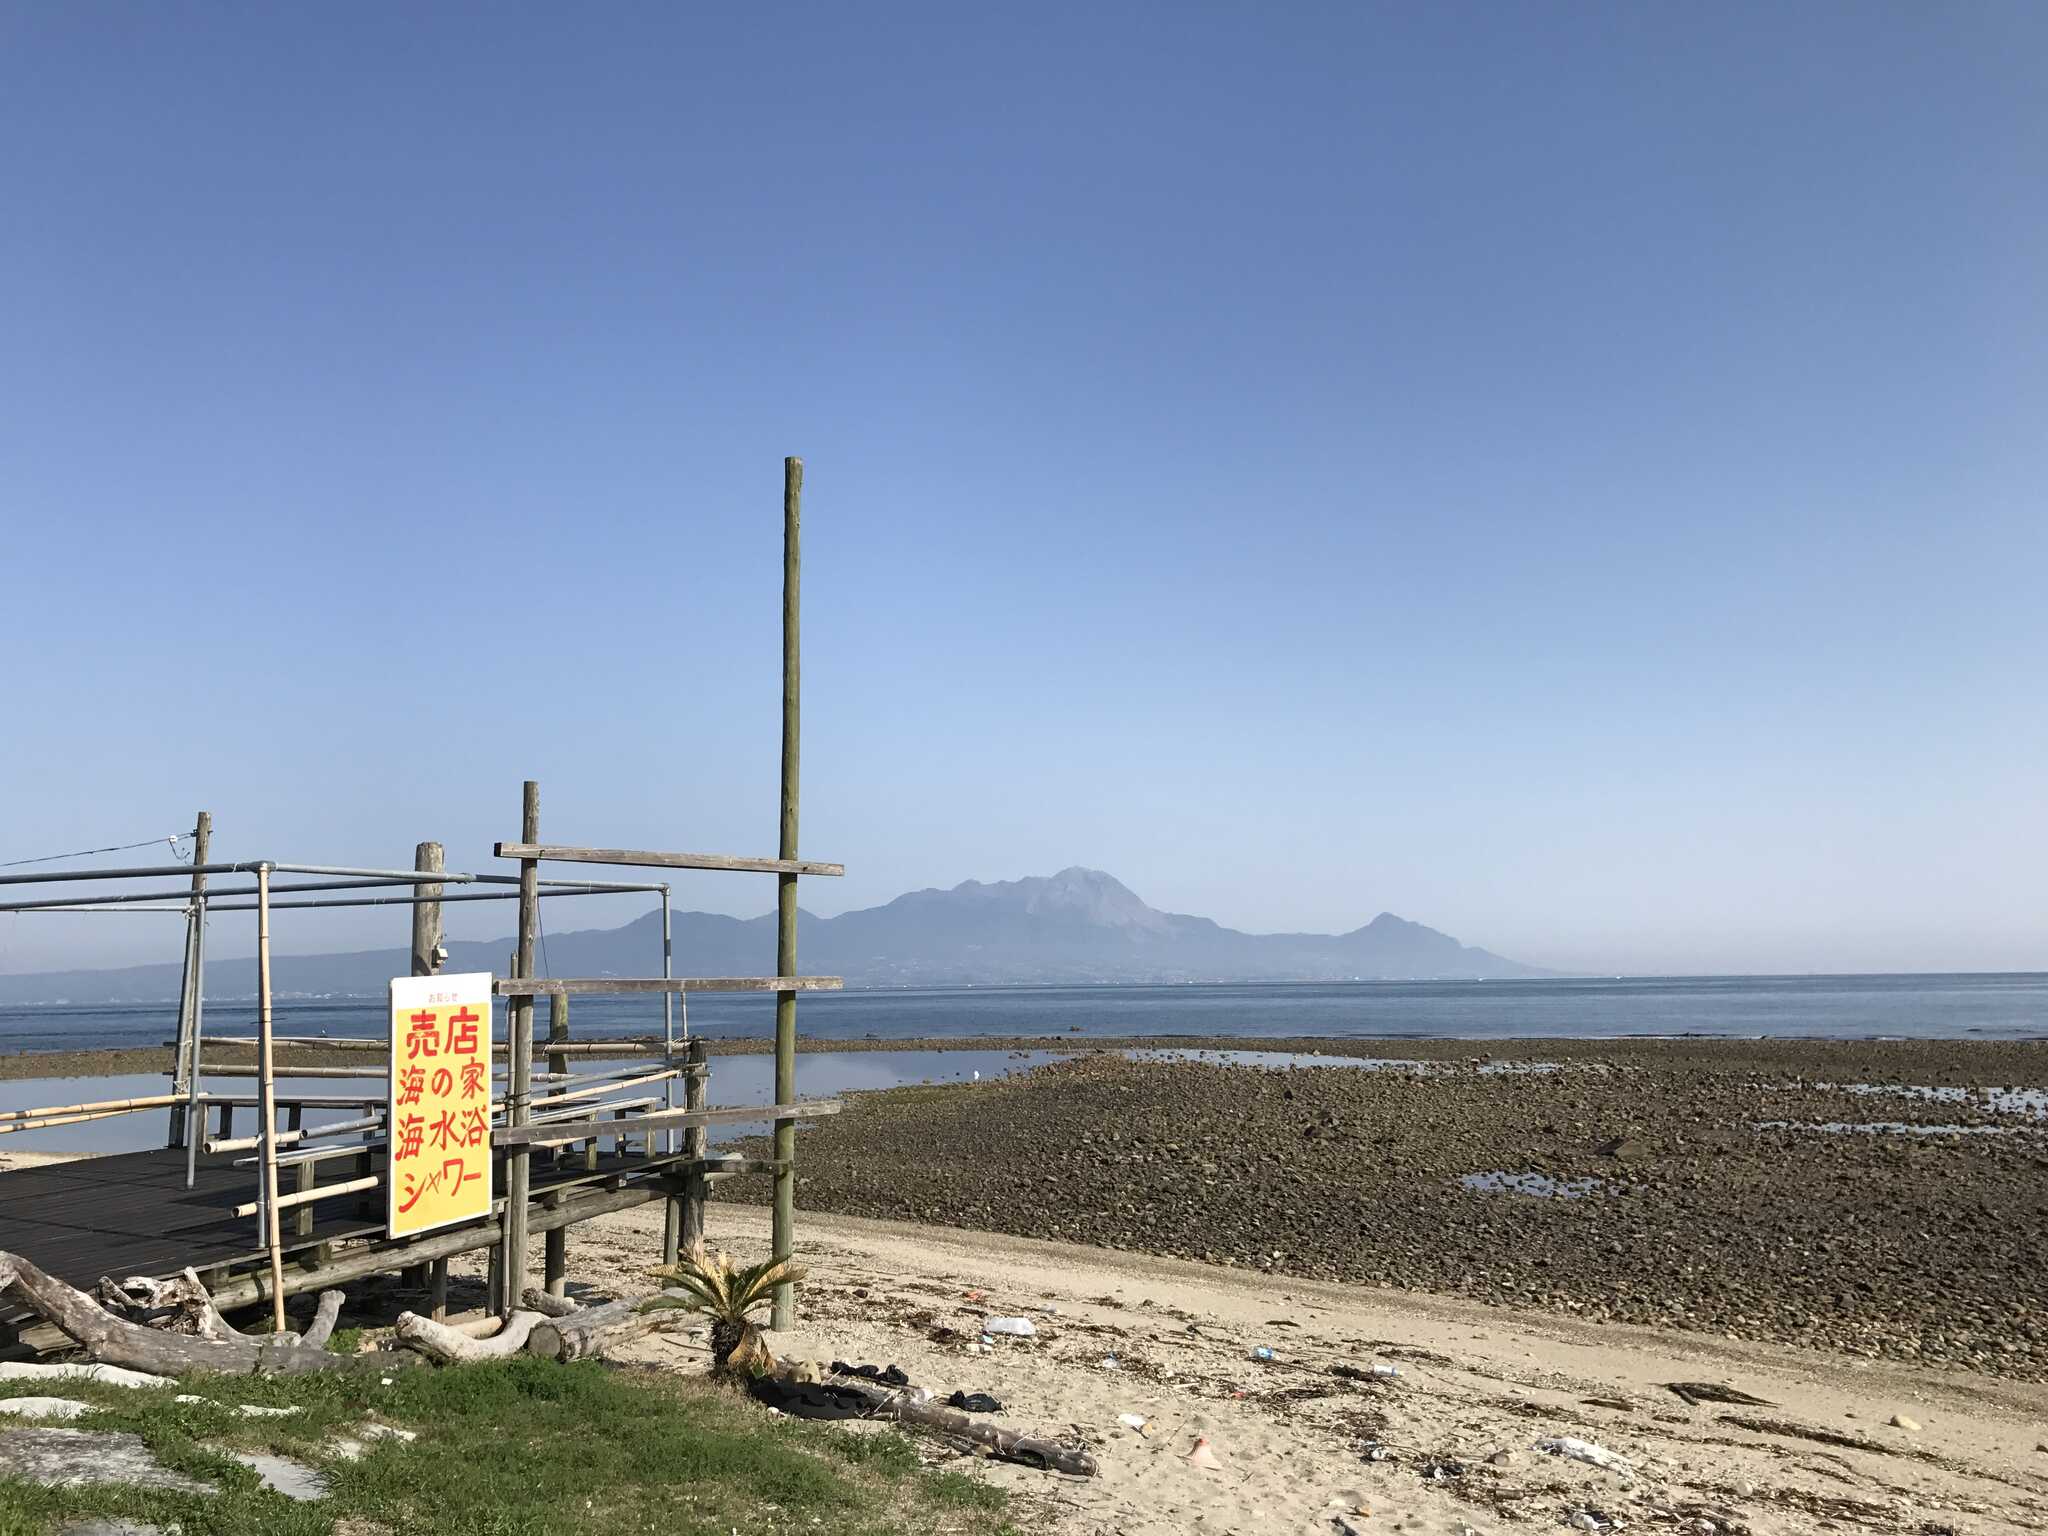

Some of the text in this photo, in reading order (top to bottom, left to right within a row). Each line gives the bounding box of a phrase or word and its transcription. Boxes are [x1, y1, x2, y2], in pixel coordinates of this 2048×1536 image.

[406, 1006, 480, 1060] 売店
[396, 1056, 485, 1106] 海の家
[394, 1105, 489, 1162] 海水浴
[398, 1158, 482, 1213] シャワー
